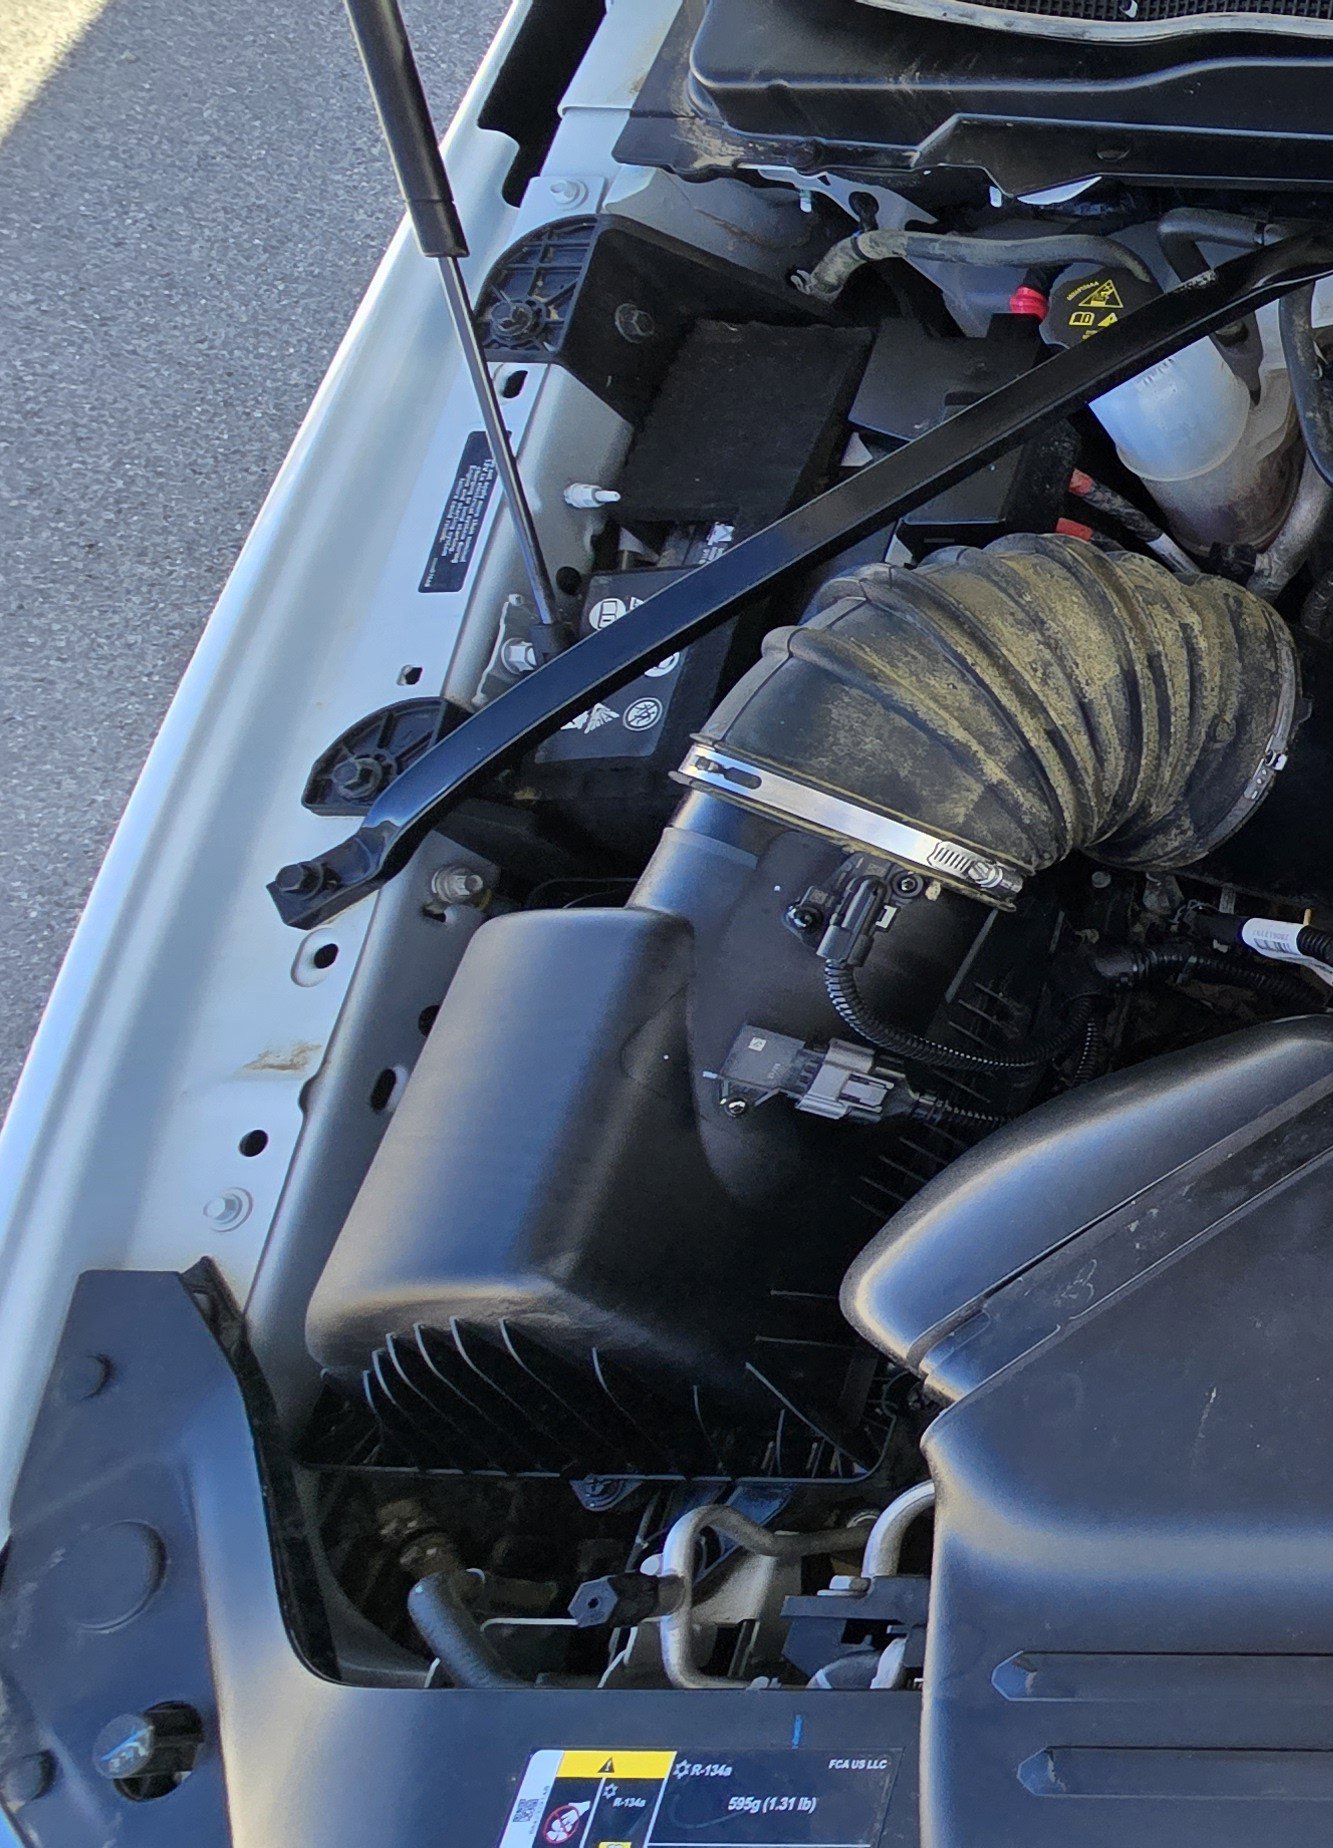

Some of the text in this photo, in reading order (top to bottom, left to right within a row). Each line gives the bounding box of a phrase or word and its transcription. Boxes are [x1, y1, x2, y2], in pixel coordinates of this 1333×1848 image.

[690, 1764, 733, 1777] R-134a
[828, 1759, 888, 1770] FCA US LLC
[728, 1797, 817, 1814] 595g (1.31 lb)
